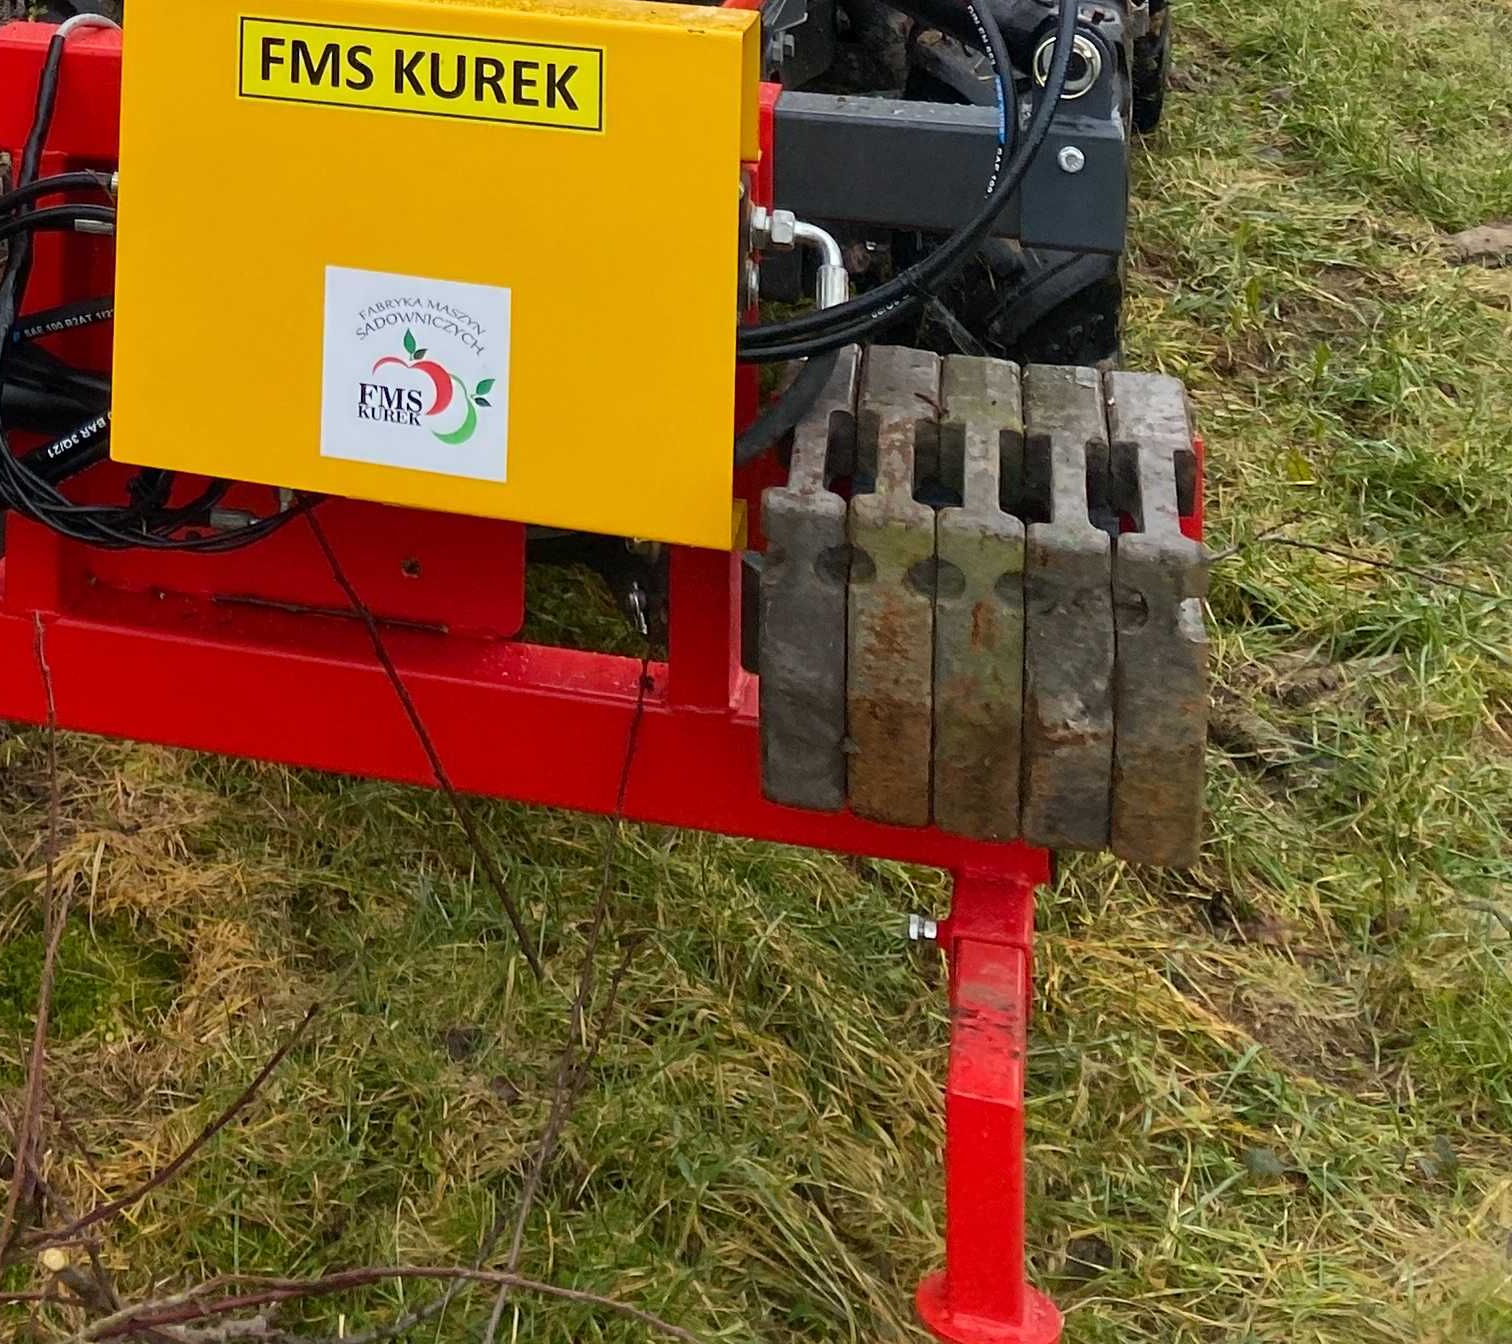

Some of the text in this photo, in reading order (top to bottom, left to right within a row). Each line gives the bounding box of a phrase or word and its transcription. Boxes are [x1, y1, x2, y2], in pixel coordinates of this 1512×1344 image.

[261, 36, 579, 111] FMS KUREK
[356, 311, 485, 356] SADOWNICZYCH
[359, 297, 487, 336] FABRYKA MASZYN
[357, 404, 422, 427] KUREK
[359, 382, 423, 413] FMS
[48, 416, 106, 459] BAR 3Q/21
